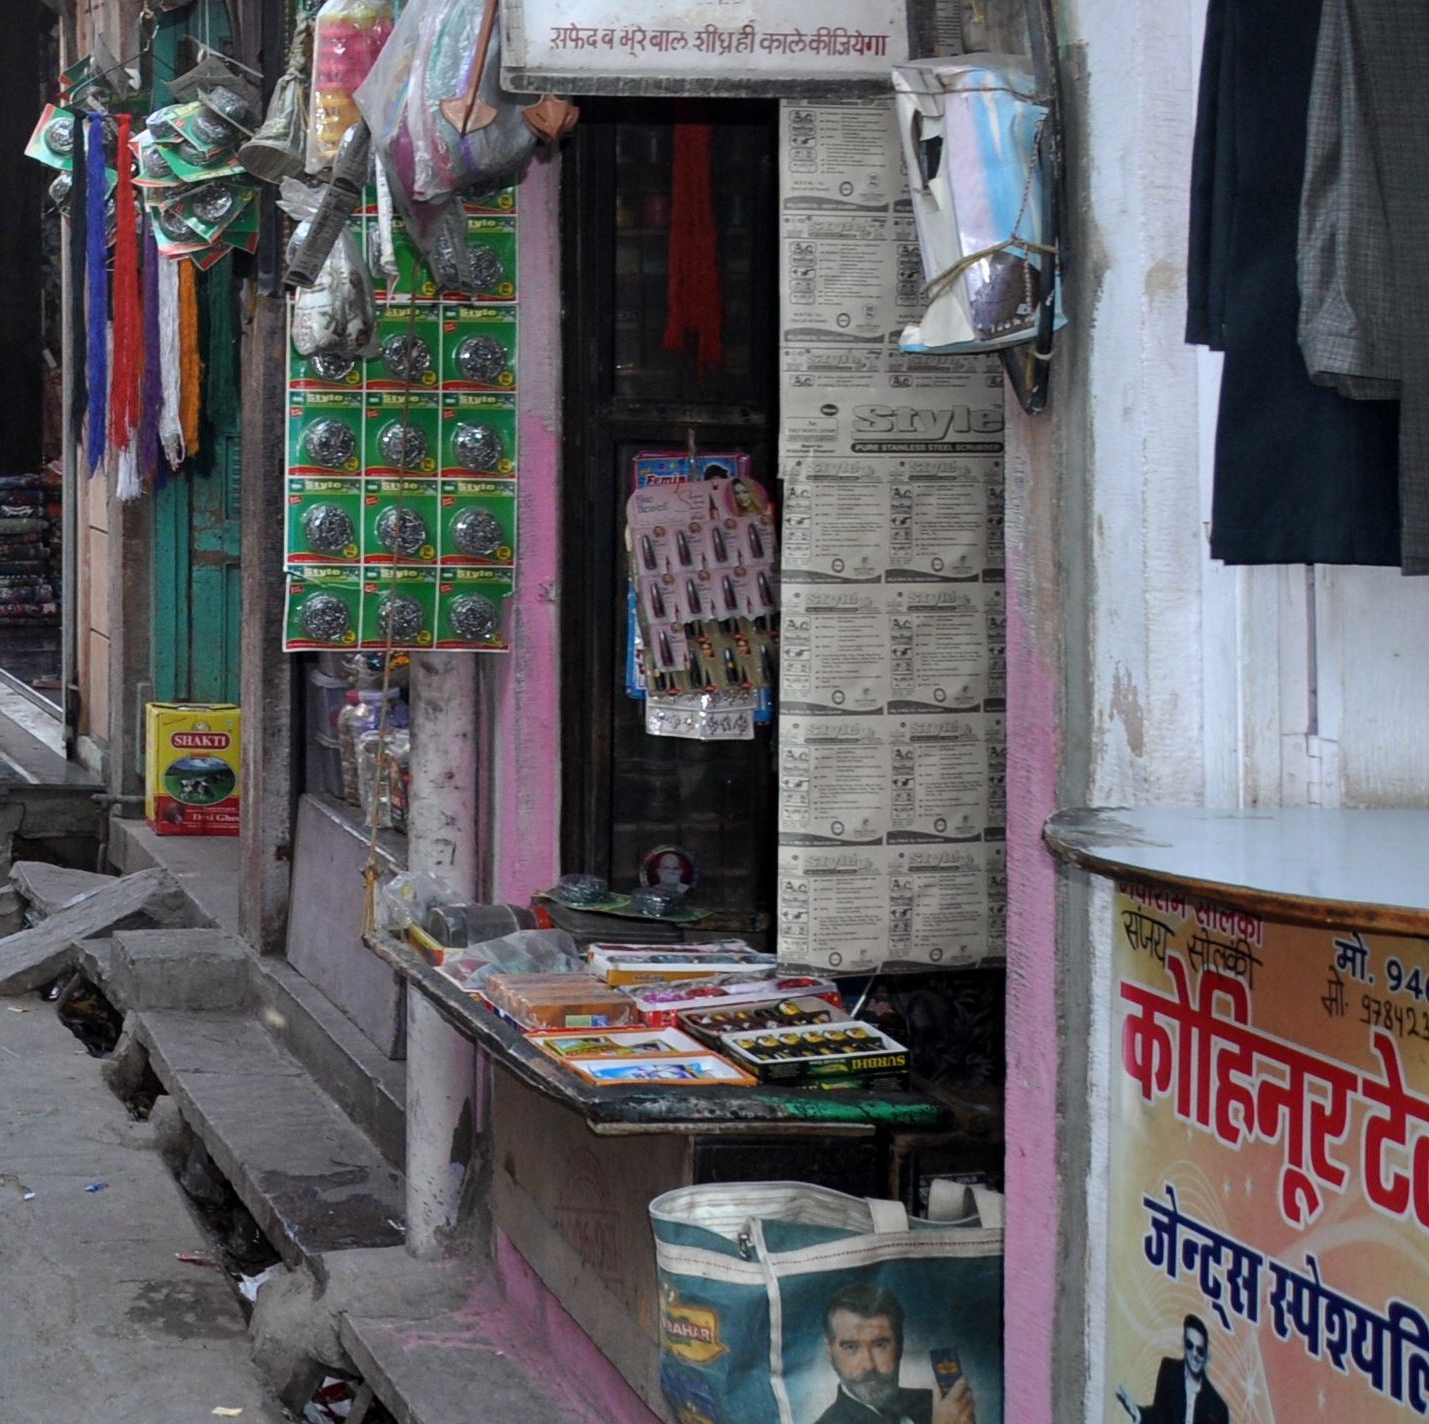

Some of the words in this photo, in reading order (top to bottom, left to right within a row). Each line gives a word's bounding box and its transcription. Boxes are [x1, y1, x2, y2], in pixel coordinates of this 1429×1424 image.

[648, 28, 689, 53] बाल
[734, 22, 756, 55] ही
[759, 26, 807, 55] काले
[852, 404, 1004, 441] Style
[174, 735, 226, 747] SHAKTI
[1335, 930, 1373, 983] मो.
[1387, 959, 1429, 1004] 94
[852, 1054, 907, 1070] SURBHI
[1121, 955, 1353, 1224] कोहिनूर
[1359, 1029, 1429, 1228] टे
[1143, 1185, 1264, 1330] जेन्ट्स
